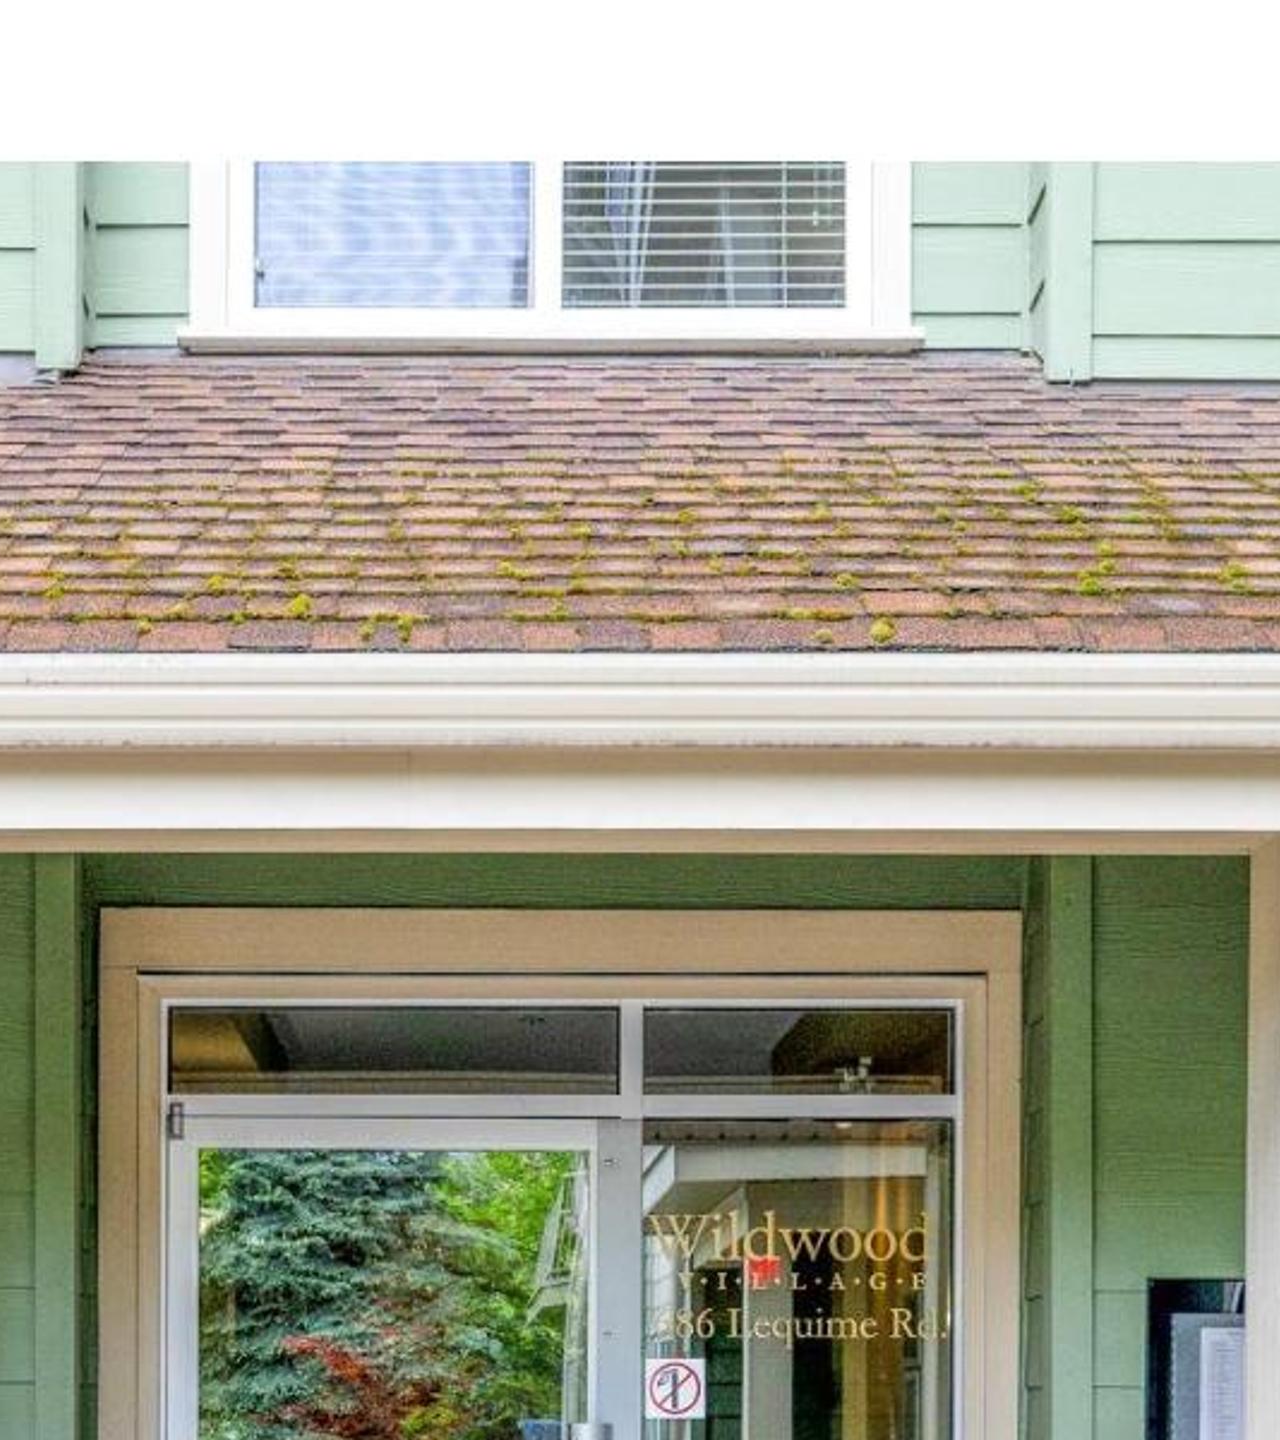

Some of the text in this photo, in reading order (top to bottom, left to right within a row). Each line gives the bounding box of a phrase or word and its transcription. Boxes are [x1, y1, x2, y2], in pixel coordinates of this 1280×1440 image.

[649, 1210, 927, 1262] Wildwood
[727, 1306, 879, 1350] Lequime
[889, 1307, 947, 1341] Rd.
